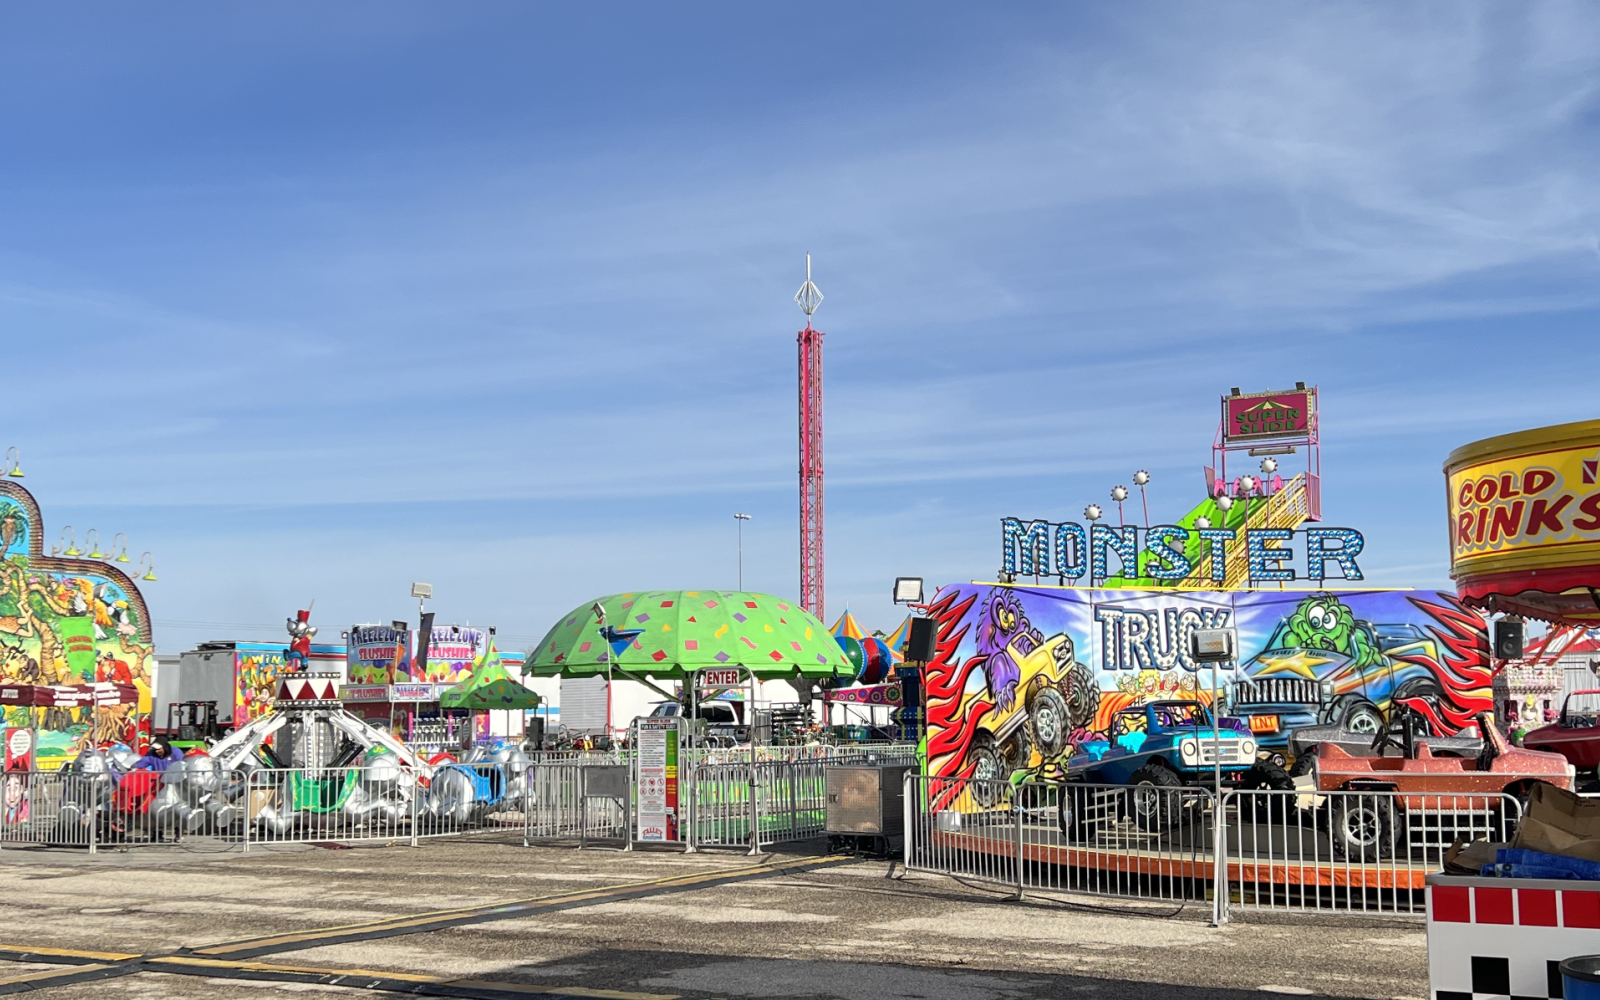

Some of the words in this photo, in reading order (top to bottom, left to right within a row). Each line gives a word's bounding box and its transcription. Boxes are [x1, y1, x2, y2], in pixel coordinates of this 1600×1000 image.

[1236, 409, 1300, 423] SUPER
[1240, 420, 1296, 434] SLIDE
[1459, 469, 1557, 508] COLD
[1002, 517, 1364, 581] MONSTER
[351, 627, 384, 646] FREEZE
[420, 627, 455, 642] EEZE
[457, 627, 482, 646] ZONE
[358, 647, 397, 659] SLUSHIE
[707, 671, 738, 684] ENTER
[53, 691, 91, 701] Jumping
